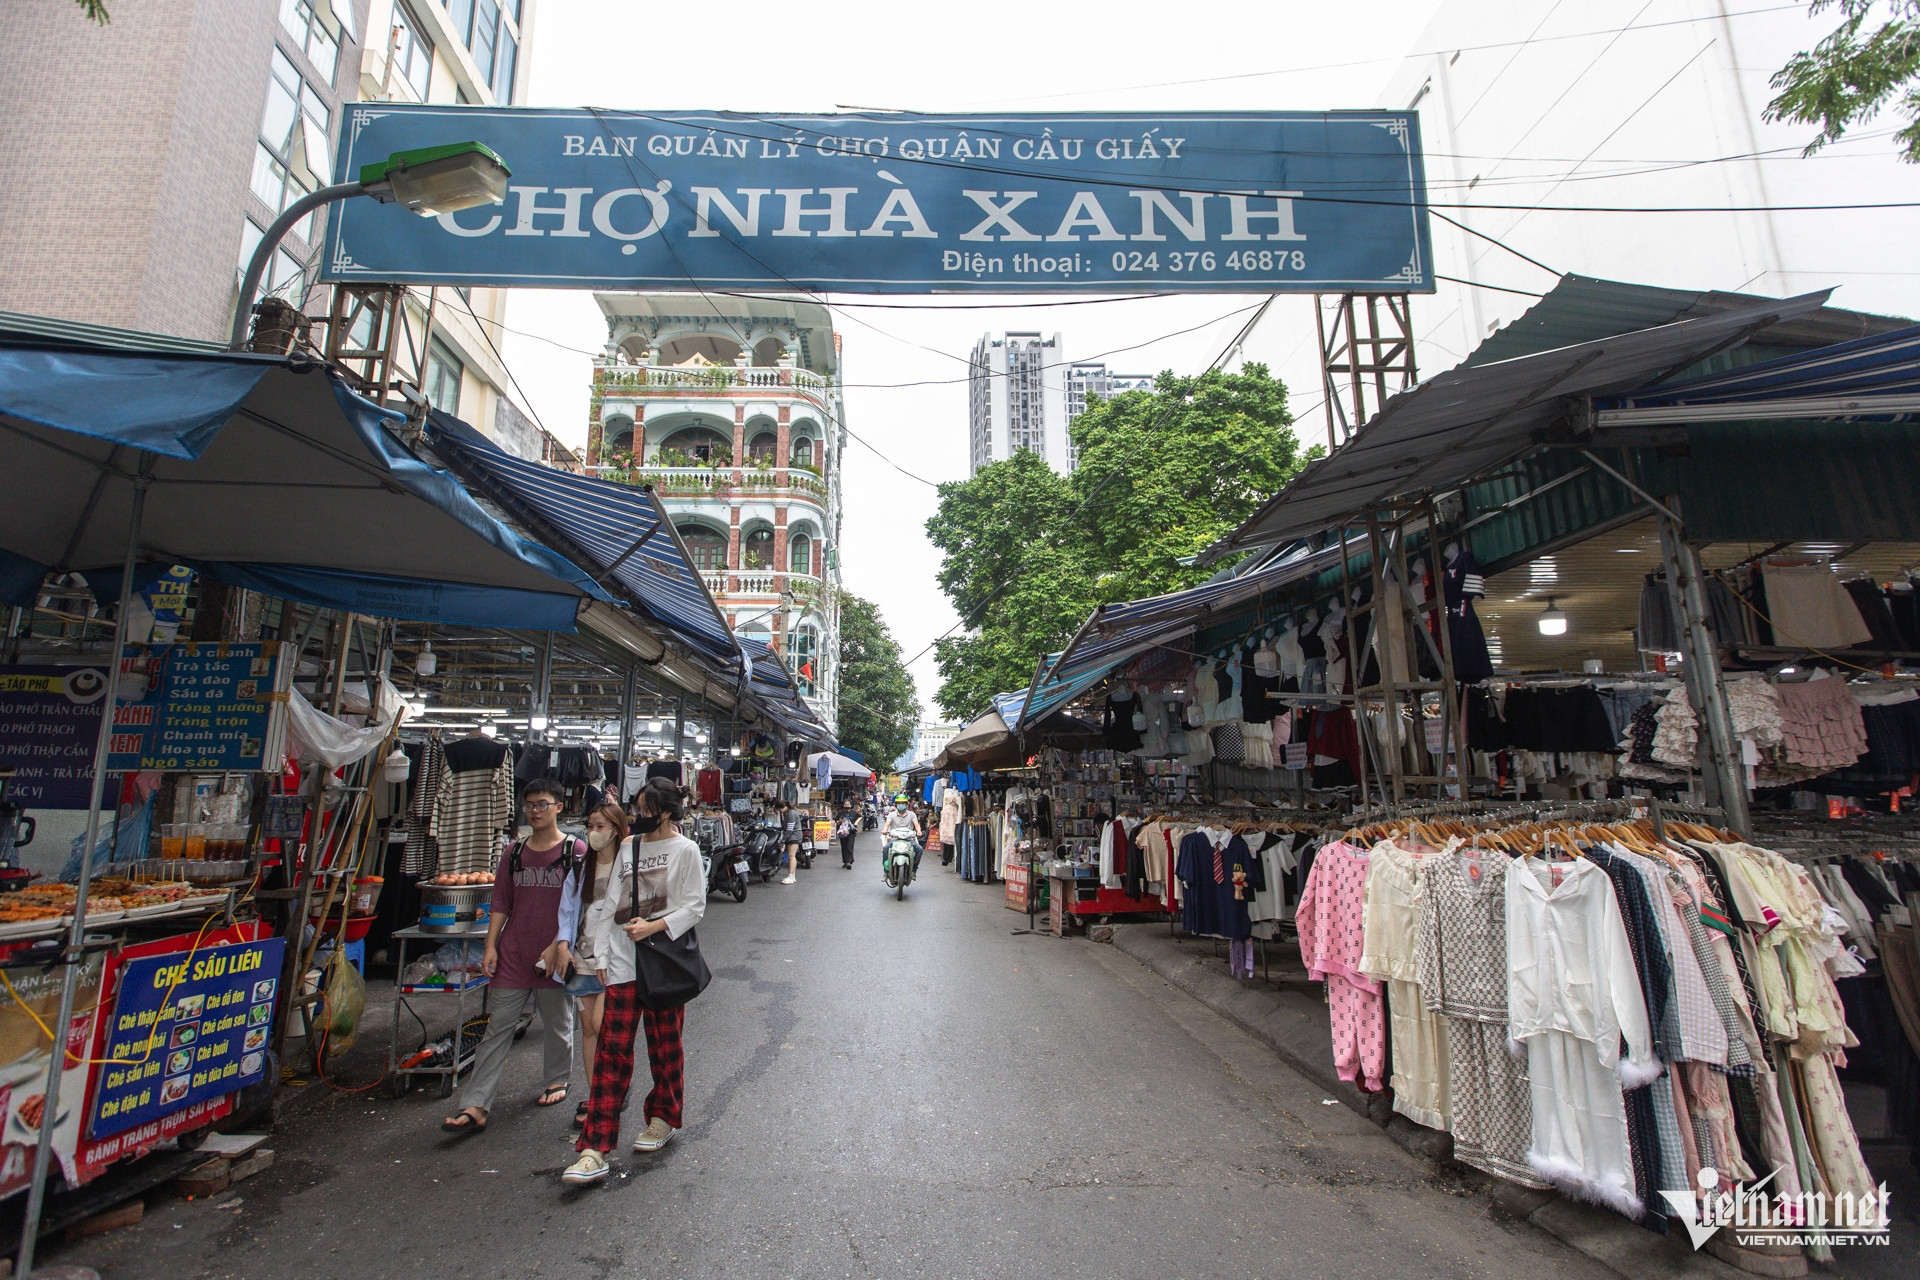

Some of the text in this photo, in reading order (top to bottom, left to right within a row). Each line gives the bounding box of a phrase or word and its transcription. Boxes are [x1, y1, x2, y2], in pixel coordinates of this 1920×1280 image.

[563, 134, 636, 157] BAN
[759, 128, 806, 160] LÝ
[816, 136, 889, 164] CHỢ
[899, 131, 1003, 163] QUẬN
[1013, 127, 1084, 160] CẦU
[1096, 127, 1186, 160] GIẤY
[688, 170, 939, 239] NHÀ
[959, 189, 1308, 243] XANH
[942, 249, 1307, 279] Điện thoại: 024 376 46878
[174, 660, 231, 672] Trà tắc
[171, 675, 231, 685] Trà đào
[15, 703, 40, 715] PHỚ
[72, 704, 105, 717] CHÂU
[112, 702, 155, 725] BÁNH
[167, 703, 266, 714] Tráng nướng
[11, 723, 36, 734] PHỚ
[38, 724, 76, 737] THẠCH
[165, 716, 249, 727] Tráng trộn
[162, 730, 249, 741] Chanh mía
[7, 742, 31, 756] PHỚ
[33, 743, 62, 758] THẬP
[161, 744, 227, 756] Hoa quả
[53, 765, 72, 779] TRÀ
[32, 786, 43, 799] VỊ
[228, 948, 263, 975] LIÊN
[206, 993, 221, 1011] Chè
[118, 1011, 137, 1032] Chè
[137, 1008, 158, 1028] thập
[201, 1013, 247, 1036] Chè cốm sen
[112, 1040, 131, 1059] Chè
[151, 1032, 167, 1050] hái
[196, 1044, 212, 1062] Chè
[107, 1068, 125, 1089] Chè
[143, 1060, 161, 1079] liên
[192, 1070, 207, 1088] Chè
[100, 1097, 119, 1119] Chè
[85, 1138, 120, 1165] BÁNH
[122, 1121, 158, 1149] TRÁNG
